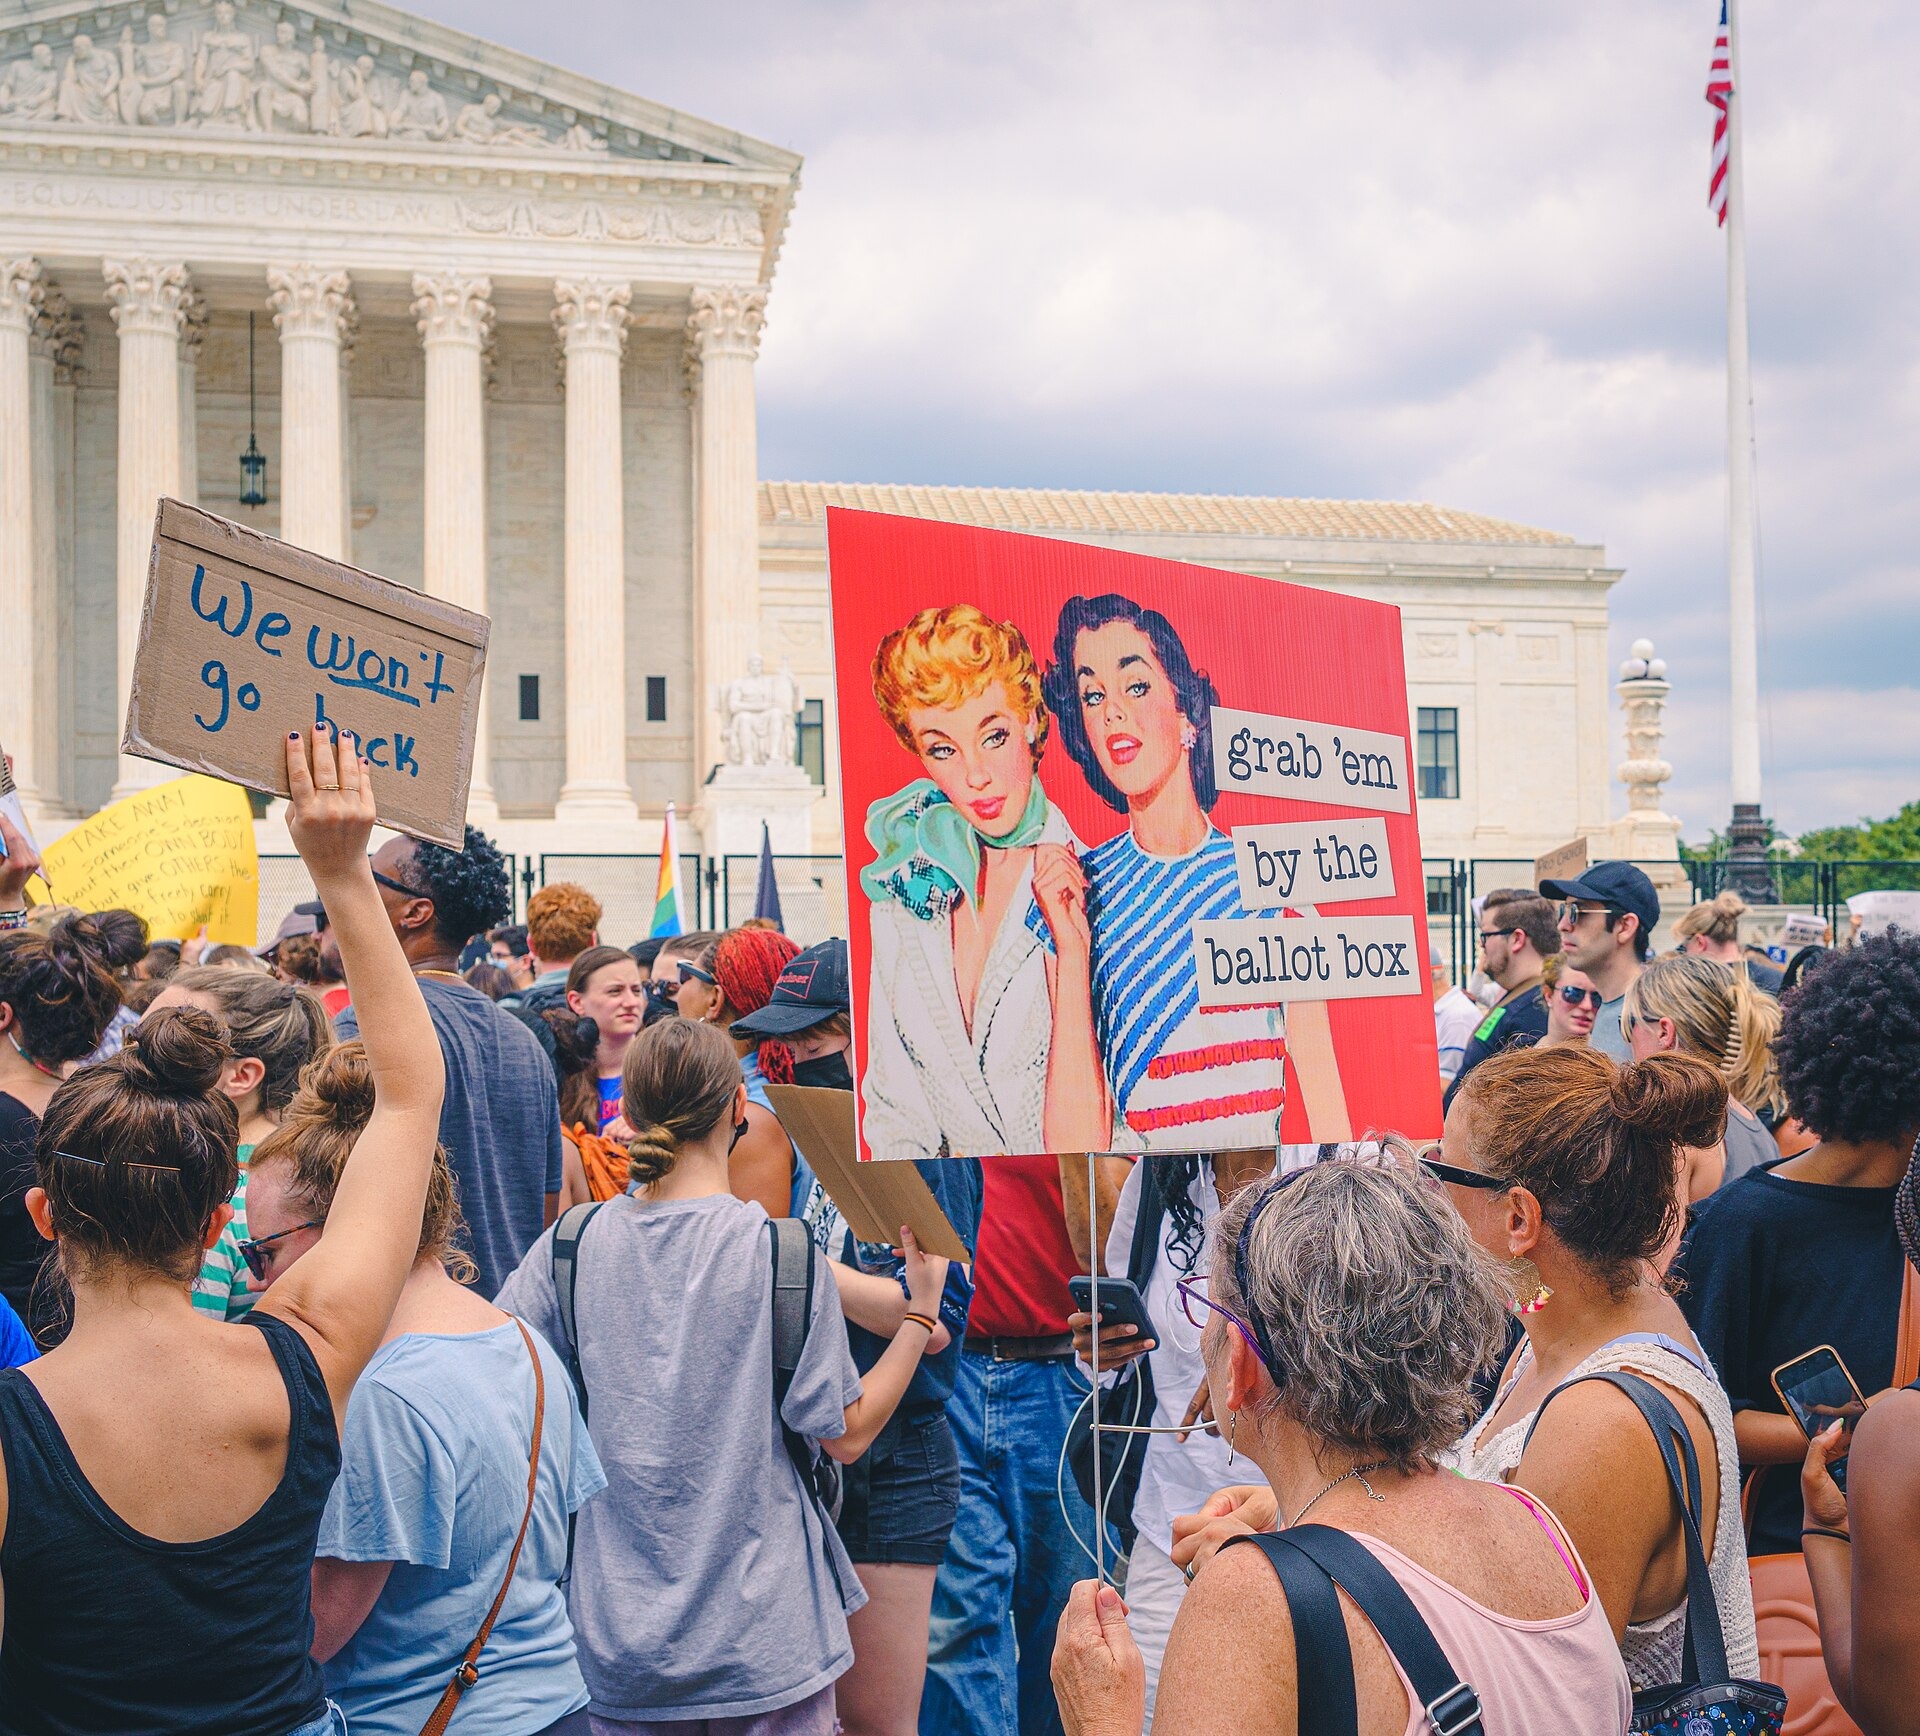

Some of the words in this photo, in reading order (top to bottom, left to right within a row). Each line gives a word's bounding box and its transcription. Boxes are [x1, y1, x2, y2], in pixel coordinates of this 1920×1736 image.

[14, 182, 119, 209] EQUAL
[126, 187, 247, 215] JUSTICE
[262, 195, 366, 220] UNDER
[375, 200, 432, 222] LAW
[190, 563, 291, 657] We
[307, 624, 455, 704] won't
[194, 659, 261, 733] go
[315, 692, 419, 778] bck
[1227, 727, 1322, 781] grab
[1333, 736, 1398, 790] 'em
[47, 856, 66, 873] ou
[67, 813, 125, 853] TAKE
[132, 789, 185, 823] AWAY
[62, 876, 97, 905] bout
[144, 834, 196, 858] OWN
[199, 829, 245, 852] BODY
[159, 854, 225, 877] OTHERS
[230, 857, 251, 880] the
[1247, 840, 1301, 898] by
[1313, 834, 1378, 883] the
[1204, 935, 1330, 986] ballot
[1337, 933, 1409, 979] box
